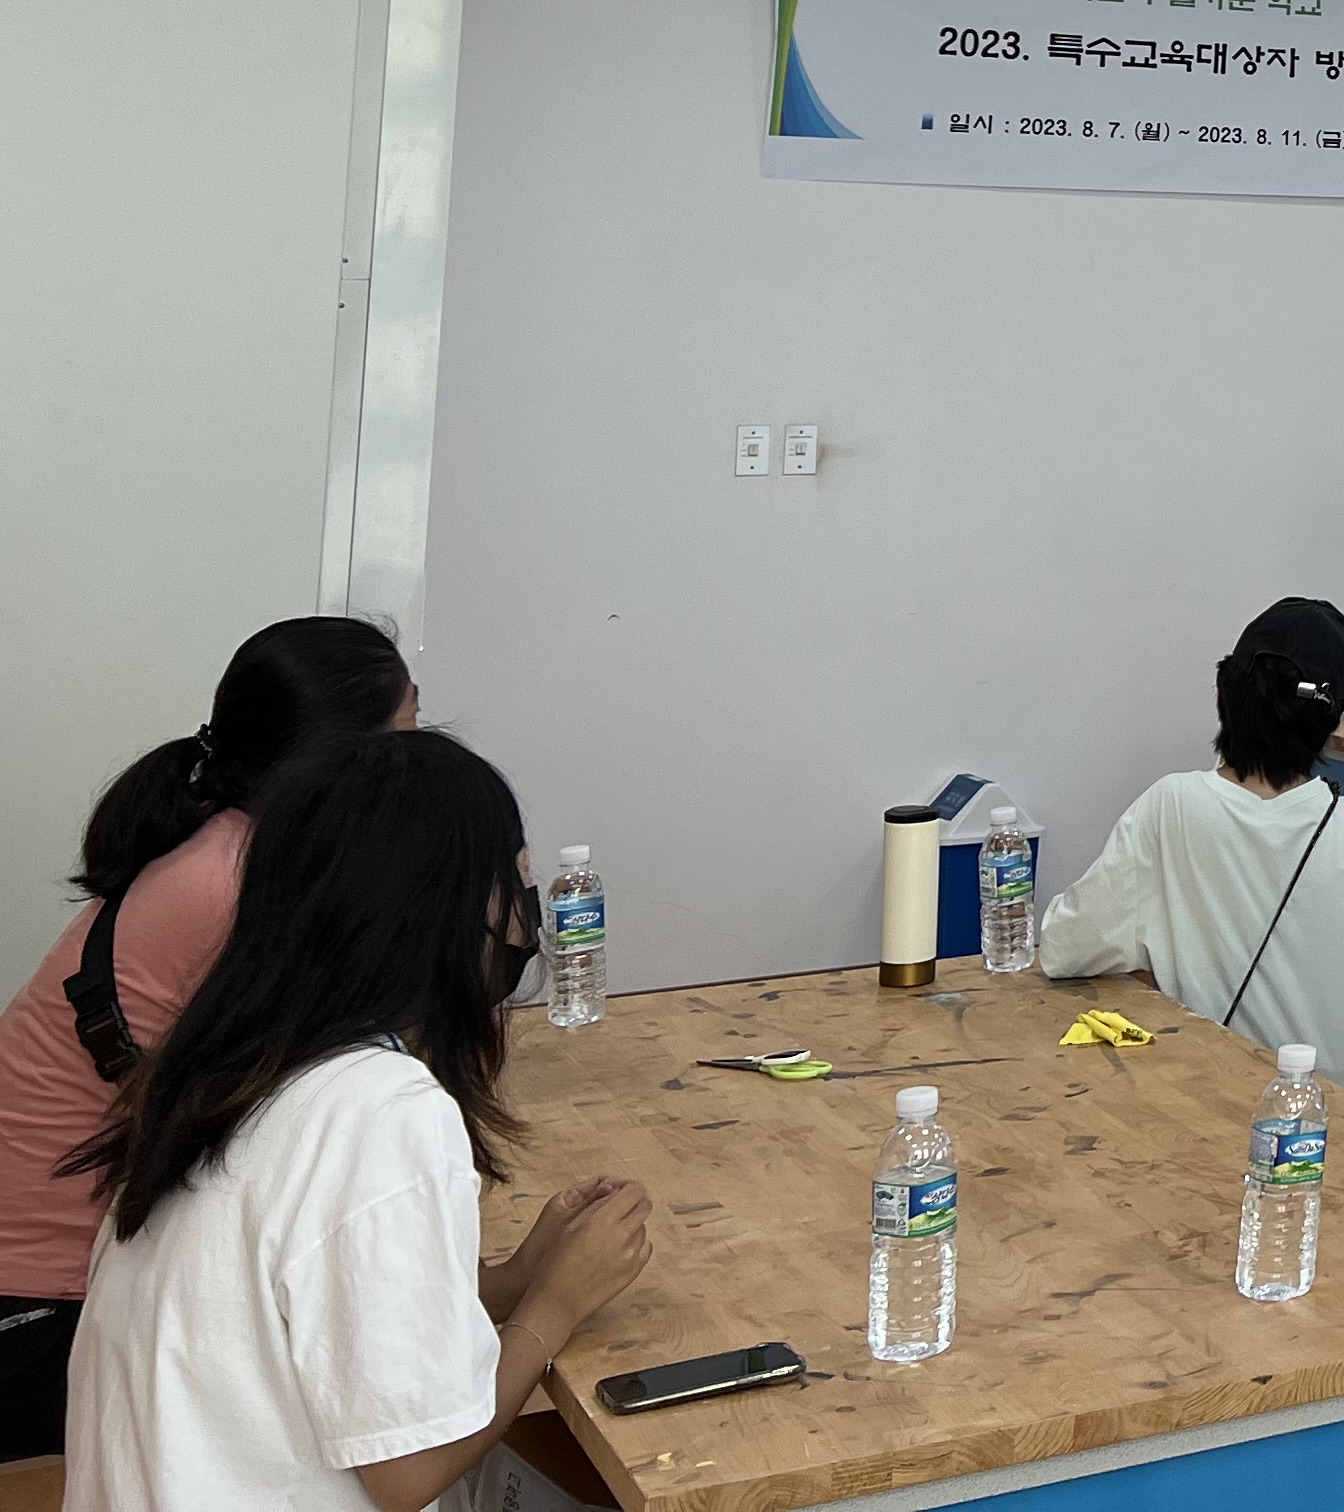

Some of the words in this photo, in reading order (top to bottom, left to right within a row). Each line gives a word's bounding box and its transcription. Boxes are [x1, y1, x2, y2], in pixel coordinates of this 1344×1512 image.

[938, 26, 1030, 61] 2023.
[1047, 33, 1299, 78] 특수교육대상자
[949, 113, 994, 135] 일시
[1020, 117, 1072, 137] 2023.
[1083, 120, 1099, 138] 8.
[1108, 121, 1125, 139] 7.
[1134, 120, 1170, 143] (월)
[1198, 125, 1248, 144] 2023.
[1256, 128, 1272, 145] 8.
[1282, 129, 1307, 147] 11.
